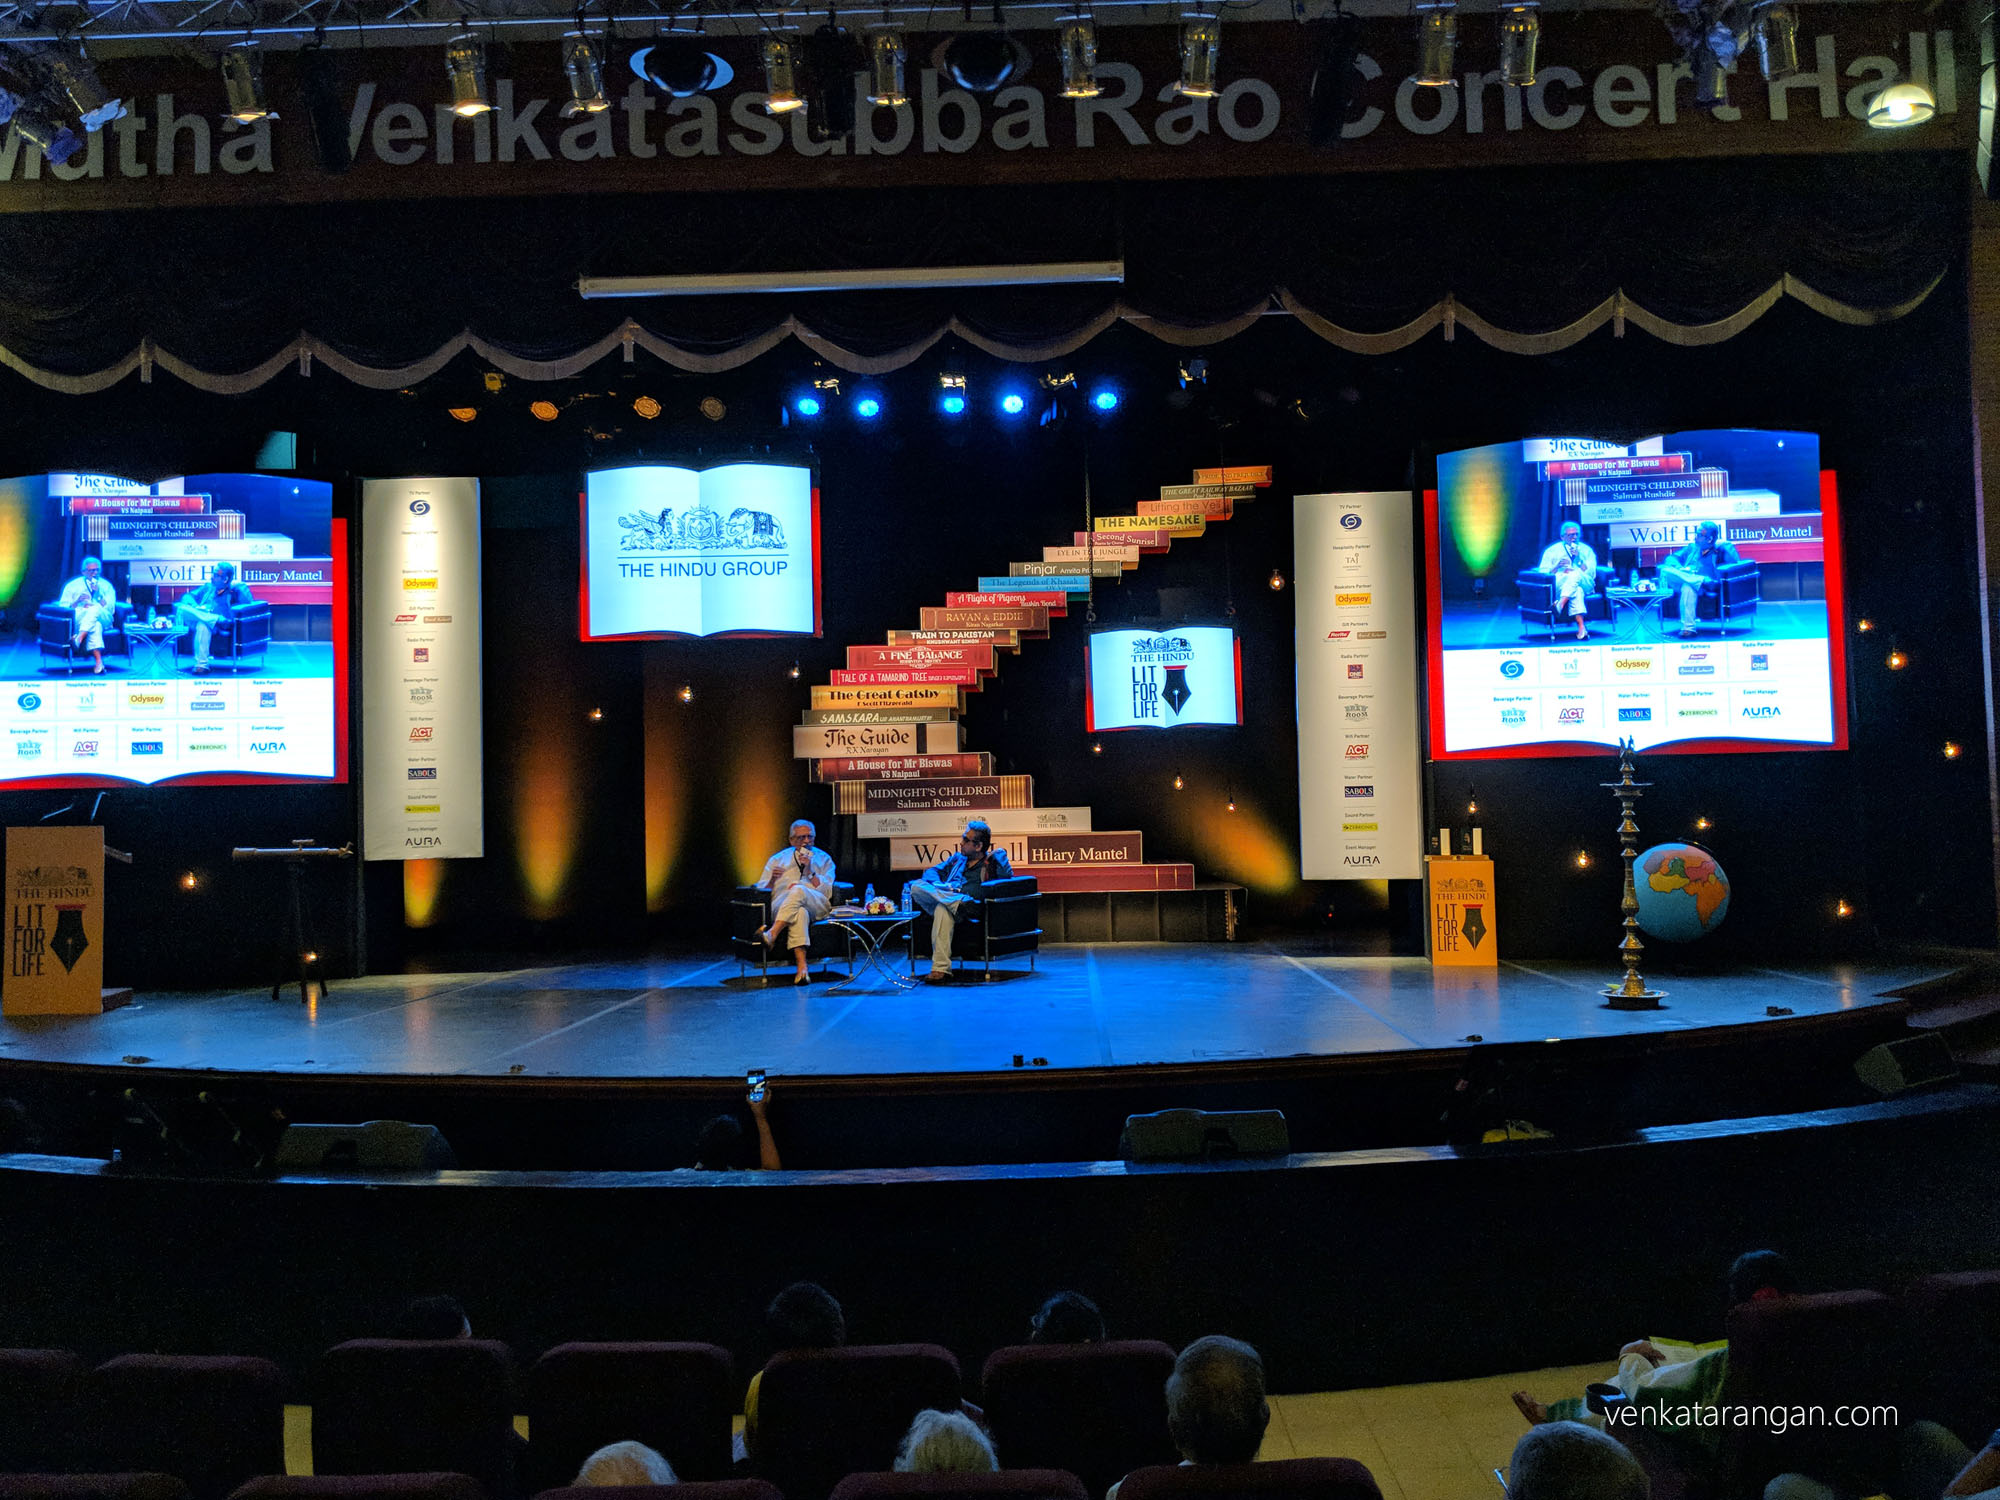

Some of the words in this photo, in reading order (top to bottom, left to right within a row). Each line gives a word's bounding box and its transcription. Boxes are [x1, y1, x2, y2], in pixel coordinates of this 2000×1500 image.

[1074, 62, 1280, 147] Rao
[1570, 462, 1577, 471] A
[1578, 461, 1603, 471] House
[1604, 460, 1616, 470] for
[1617, 459, 1630, 469] Mr
[1631, 459, 1660, 468] Biswas
[1588, 482, 1647, 493] MIDNIGHT'S
[1648, 479, 1700, 490] CHILDREN
[1613, 492, 1642, 500] Salman
[1644, 490, 1676, 498] Rushdie
[94, 499, 101, 507] A
[101, 498, 126, 507] House
[127, 498, 139, 507] for
[140, 498, 151, 507] Mr
[152, 498, 180, 507] Biswas
[1150, 503, 1180, 513] Lifting
[1183, 502, 1200, 510] the
[110, 521, 167, 530] MIDNIGHT'S
[168, 521, 218, 529] CHILDREN
[1101, 517, 1125, 528] THE
[1130, 514, 1200, 527] NAMESAKE
[134, 530, 162, 538] Salman
[1096, 532, 1125, 541] Second
[1127, 535, 1155, 545] Sunrise
[1629, 525, 1678, 543] Wolf
[1729, 528, 1767, 542] Hilary
[1770, 525, 1812, 539] Mantel
[1099, 548, 1128, 556] JUNGLE
[149, 565, 196, 581] Wolf
[244, 569, 281, 583] Hilary
[282, 569, 323, 581] Mantel
[618, 563, 655, 578] THE
[660, 562, 717, 577] HINDU
[722, 561, 788, 576] GROUP
[1024, 563, 1057, 577] Pinjar
[405, 578, 437, 589] Odyssey
[991, 578, 1006, 586] The
[1008, 578, 1040, 588] Legends
[1040, 577, 1049, 585] of
[957, 593, 965, 604] A
[966, 593, 988, 604] Flight
[988, 593, 998, 604] of
[997, 593, 1026, 605] Pigeons
[1337, 593, 1369, 604] Odyssey
[946, 612, 982, 622] RAVAN
[993, 612, 1024, 621] EDDIE
[911, 631, 937, 640] TRAIN
[940, 631, 951, 639] TO
[952, 631, 995, 639] PAKISTAN
[878, 651, 886, 661] A
[890, 651, 913, 660] FINE
[917, 650, 963, 660] BALANCE
[1131, 654, 1155, 663] THE
[1157, 652, 1195, 662] HINDU
[1615, 658, 1651, 669] Odyssey
[841, 673, 857, 683] TALE
[858, 673, 868, 682] OF
[869, 673, 876, 682] A
[877, 672, 909, 682] TAMARIND
[911, 672, 928, 682] TREE
[1132, 665, 1157, 684] LIT
[830, 690, 853, 701] The
[856, 689, 893, 700] Great
[895, 689, 940, 700] Gatsby
[1132, 682, 1158, 702] FOR
[130, 693, 165, 704] Odyssey
[1133, 700, 1159, 719] LIFE
[1559, 708, 1584, 720] ACT
[1619, 710, 1650, 719] SABOLS
[1742, 706, 1781, 716] AURA
[820, 712, 880, 724] SAMSKARA
[1502, 716, 1527, 724] ROOM
[410, 727, 433, 738] ACT
[824, 728, 857, 749] The
[860, 728, 910, 746] Guide
[74, 741, 99, 753] ACT
[132, 743, 163, 752] SABOLS
[250, 742, 287, 751] AURA
[860, 746, 889, 756] Narayan
[1345, 744, 1369, 755] ACT
[848, 760, 856, 770] A
[856, 759, 887, 770] House
[888, 759, 902, 769] for
[904, 758, 918, 769] Mr
[919, 757, 953, 769] Biswas
[408, 769, 437, 778] SABOLS
[881, 771, 891, 779] VS
[891, 770, 920, 780] Naipaul
[868, 787, 937, 799] MIDNIGHT'S
[938, 785, 999, 796] CHILDREN
[1344, 786, 1374, 796] SABOLS
[897, 799, 931, 809] Salman
[933, 797, 971, 808] Rushdie
[405, 836, 442, 846] AURA
[1031, 847, 1075, 865] Hilary
[1079, 845, 1128, 862] Mantel
[1343, 855, 1381, 865] AURA
[14, 888, 41, 899] THE
[49, 887, 95, 899] HINDU
[1457, 892, 1490, 900] HINDU
[14, 904, 46, 929] LIT
[1436, 903, 1458, 920] LIT
[1437, 919, 1459, 936] FOR
[13, 928, 46, 953] FOR
[1438, 935, 1460, 952] LIFE
[12, 952, 45, 977] LIFE
